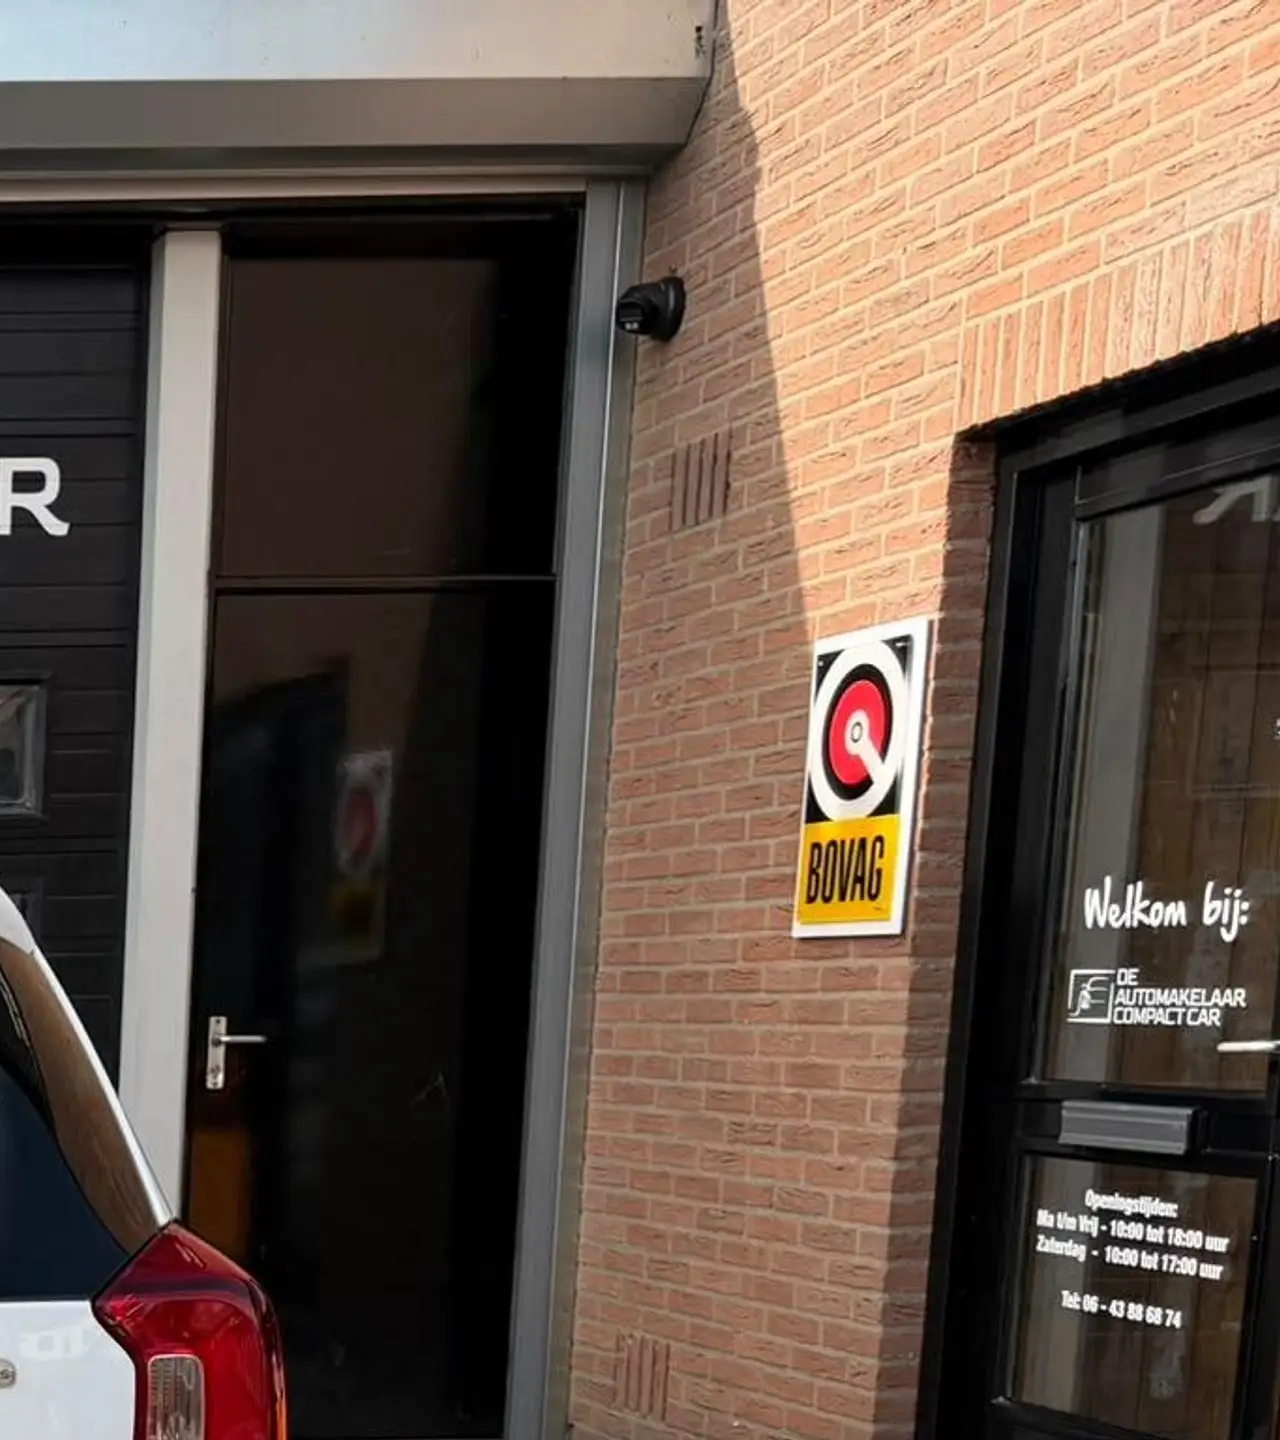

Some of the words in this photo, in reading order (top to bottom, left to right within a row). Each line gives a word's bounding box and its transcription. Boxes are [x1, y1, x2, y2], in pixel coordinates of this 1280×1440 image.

[806, 835, 884, 904] BOVAG
[1084, 875, 1187, 929] Welkom
[1203, 881, 1250, 943] bij:
[1117, 968, 1139, 985] DE
[1115, 988, 1247, 1007] AUTOMAKELAAR
[1113, 1008, 1187, 1025] COMPACT
[1187, 1008, 1221, 1026] CAR
[1085, 1189, 1178, 1218] Openingstijden:
[1109, 1220, 1144, 1241] 10:00
[1146, 1224, 1165, 1244] tot
[1205, 1235, 1230, 1253] uur
[1036, 1234, 1087, 1262] Zaterdag
[1104, 1245, 1139, 1267] 10:00
[1141, 1250, 1160, 1270] tot
[1161, 1254, 1197, 1276] 17:00
[1199, 1262, 1224, 1280] uur
[1108, 1299, 1125, 1318] 43
[1165, 1309, 1182, 1329] 74
